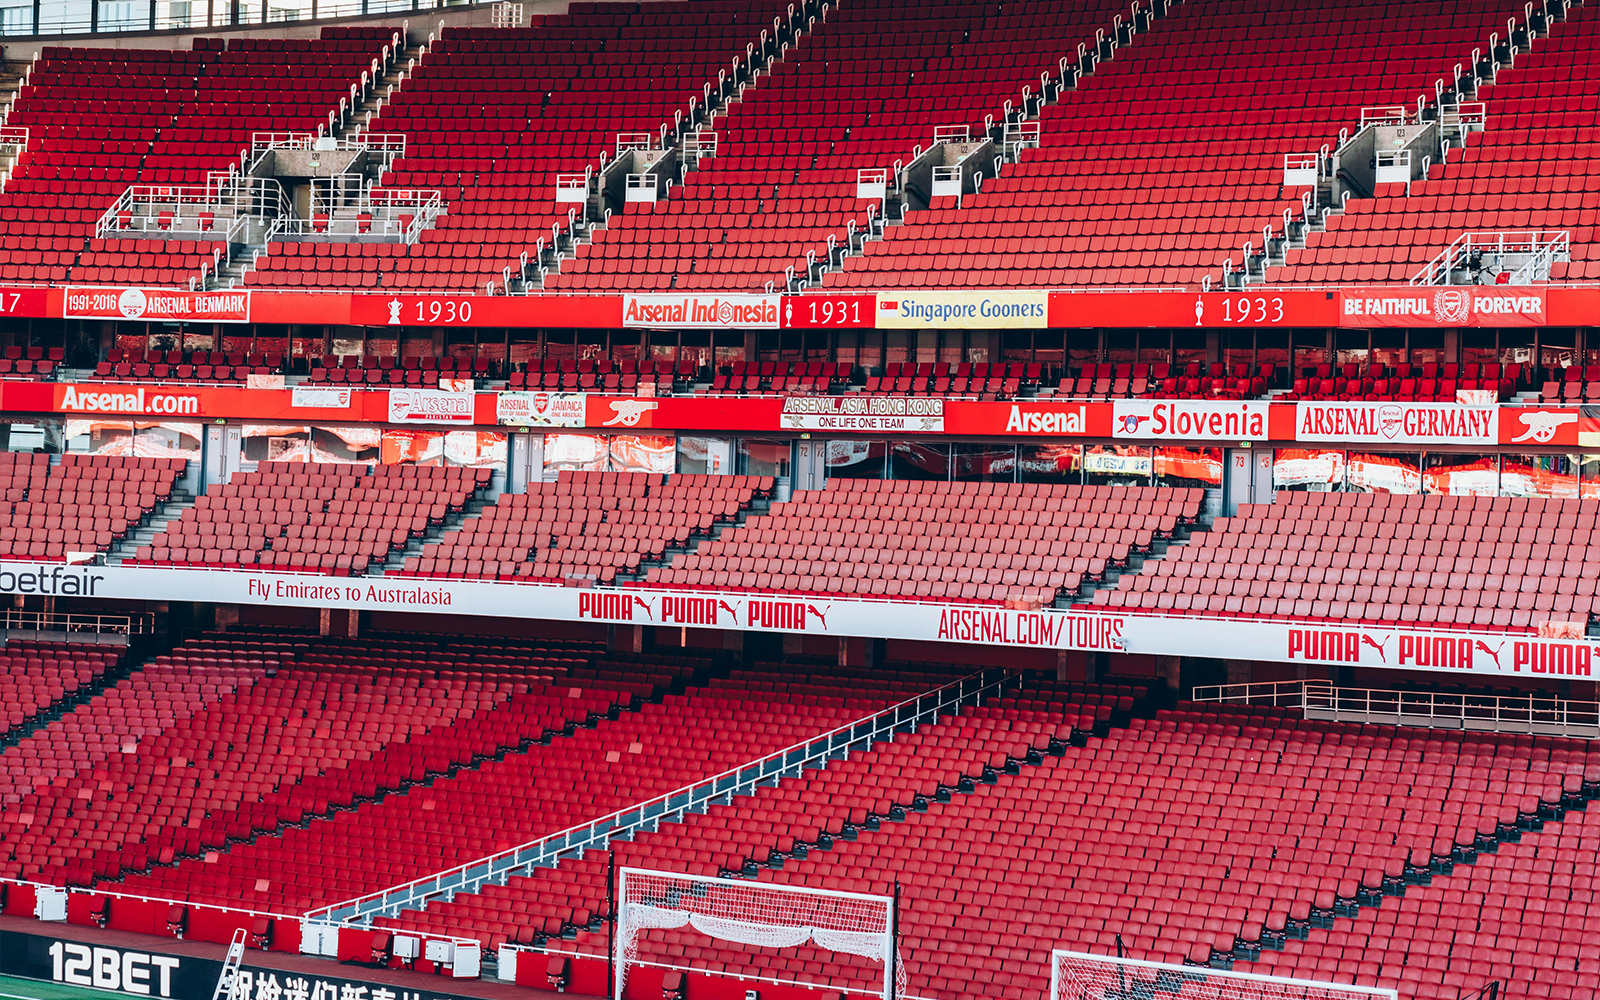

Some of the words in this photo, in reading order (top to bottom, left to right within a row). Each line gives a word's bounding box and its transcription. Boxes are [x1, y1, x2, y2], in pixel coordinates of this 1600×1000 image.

[1396, 128, 1406, 137] 123
[960, 145, 968, 153] 122
[0, 293, 21, 313] 17
[68, 294, 117, 311] 1991-2016
[147, 296, 192, 314] ARSENAL
[194, 295, 246, 313] DENMARK
[415, 300, 472, 323] 1930
[624, 298, 687, 324] Arsenal
[808, 300, 861, 324] 1931
[900, 299, 977, 322] Singapore
[979, 298, 1045, 318] Gooners
[1221, 297, 1285, 323] 1933
[1344, 298, 1363, 315] BE
[1364, 298, 1431, 315] FAITHFUL
[1473, 296, 1542, 314] FOREVER
[60, 385, 198, 414] Arsenal.com
[408, 391, 474, 414] Arsenal
[500, 399, 530, 410] ARSENAL
[551, 400, 583, 411] JAMAICA
[783, 397, 838, 414] ARSENAL
[839, 398, 868, 414] ASIA
[869, 398, 906, 415] HONG
[906, 398, 943, 415] KONG
[818, 417, 837, 428] ONE
[838, 418, 857, 428] LIFE
[858, 418, 877, 428] ONE
[878, 418, 905, 429] TEAM
[1006, 405, 1086, 433] Arsenal
[1151, 403, 1264, 436] Slovenia
[1301, 406, 1379, 435] ARSENAL
[1403, 408, 1493, 438] GERMANY
[515, 439, 524, 450] 71
[800, 446, 809, 457] 72
[1235, 456, 1245, 467] 73
[0, 564, 104, 596] betfair
[248, 578, 271, 601] Fly
[275, 580, 340, 601] Emirates
[345, 584, 361, 601] to
[366, 584, 452, 606] Australasia
[578, 592, 633, 620] PUMA
[661, 596, 718, 625] PUMA
[747, 600, 806, 630] PUMA
[937, 608, 1124, 650] ARSENAL.COM/TOURS
[1288, 629, 1360, 662] PUMA
[1398, 635, 1473, 669] PUMA
[1513, 641, 1591, 676] PUMA
[48, 941, 180, 997] 12BET
